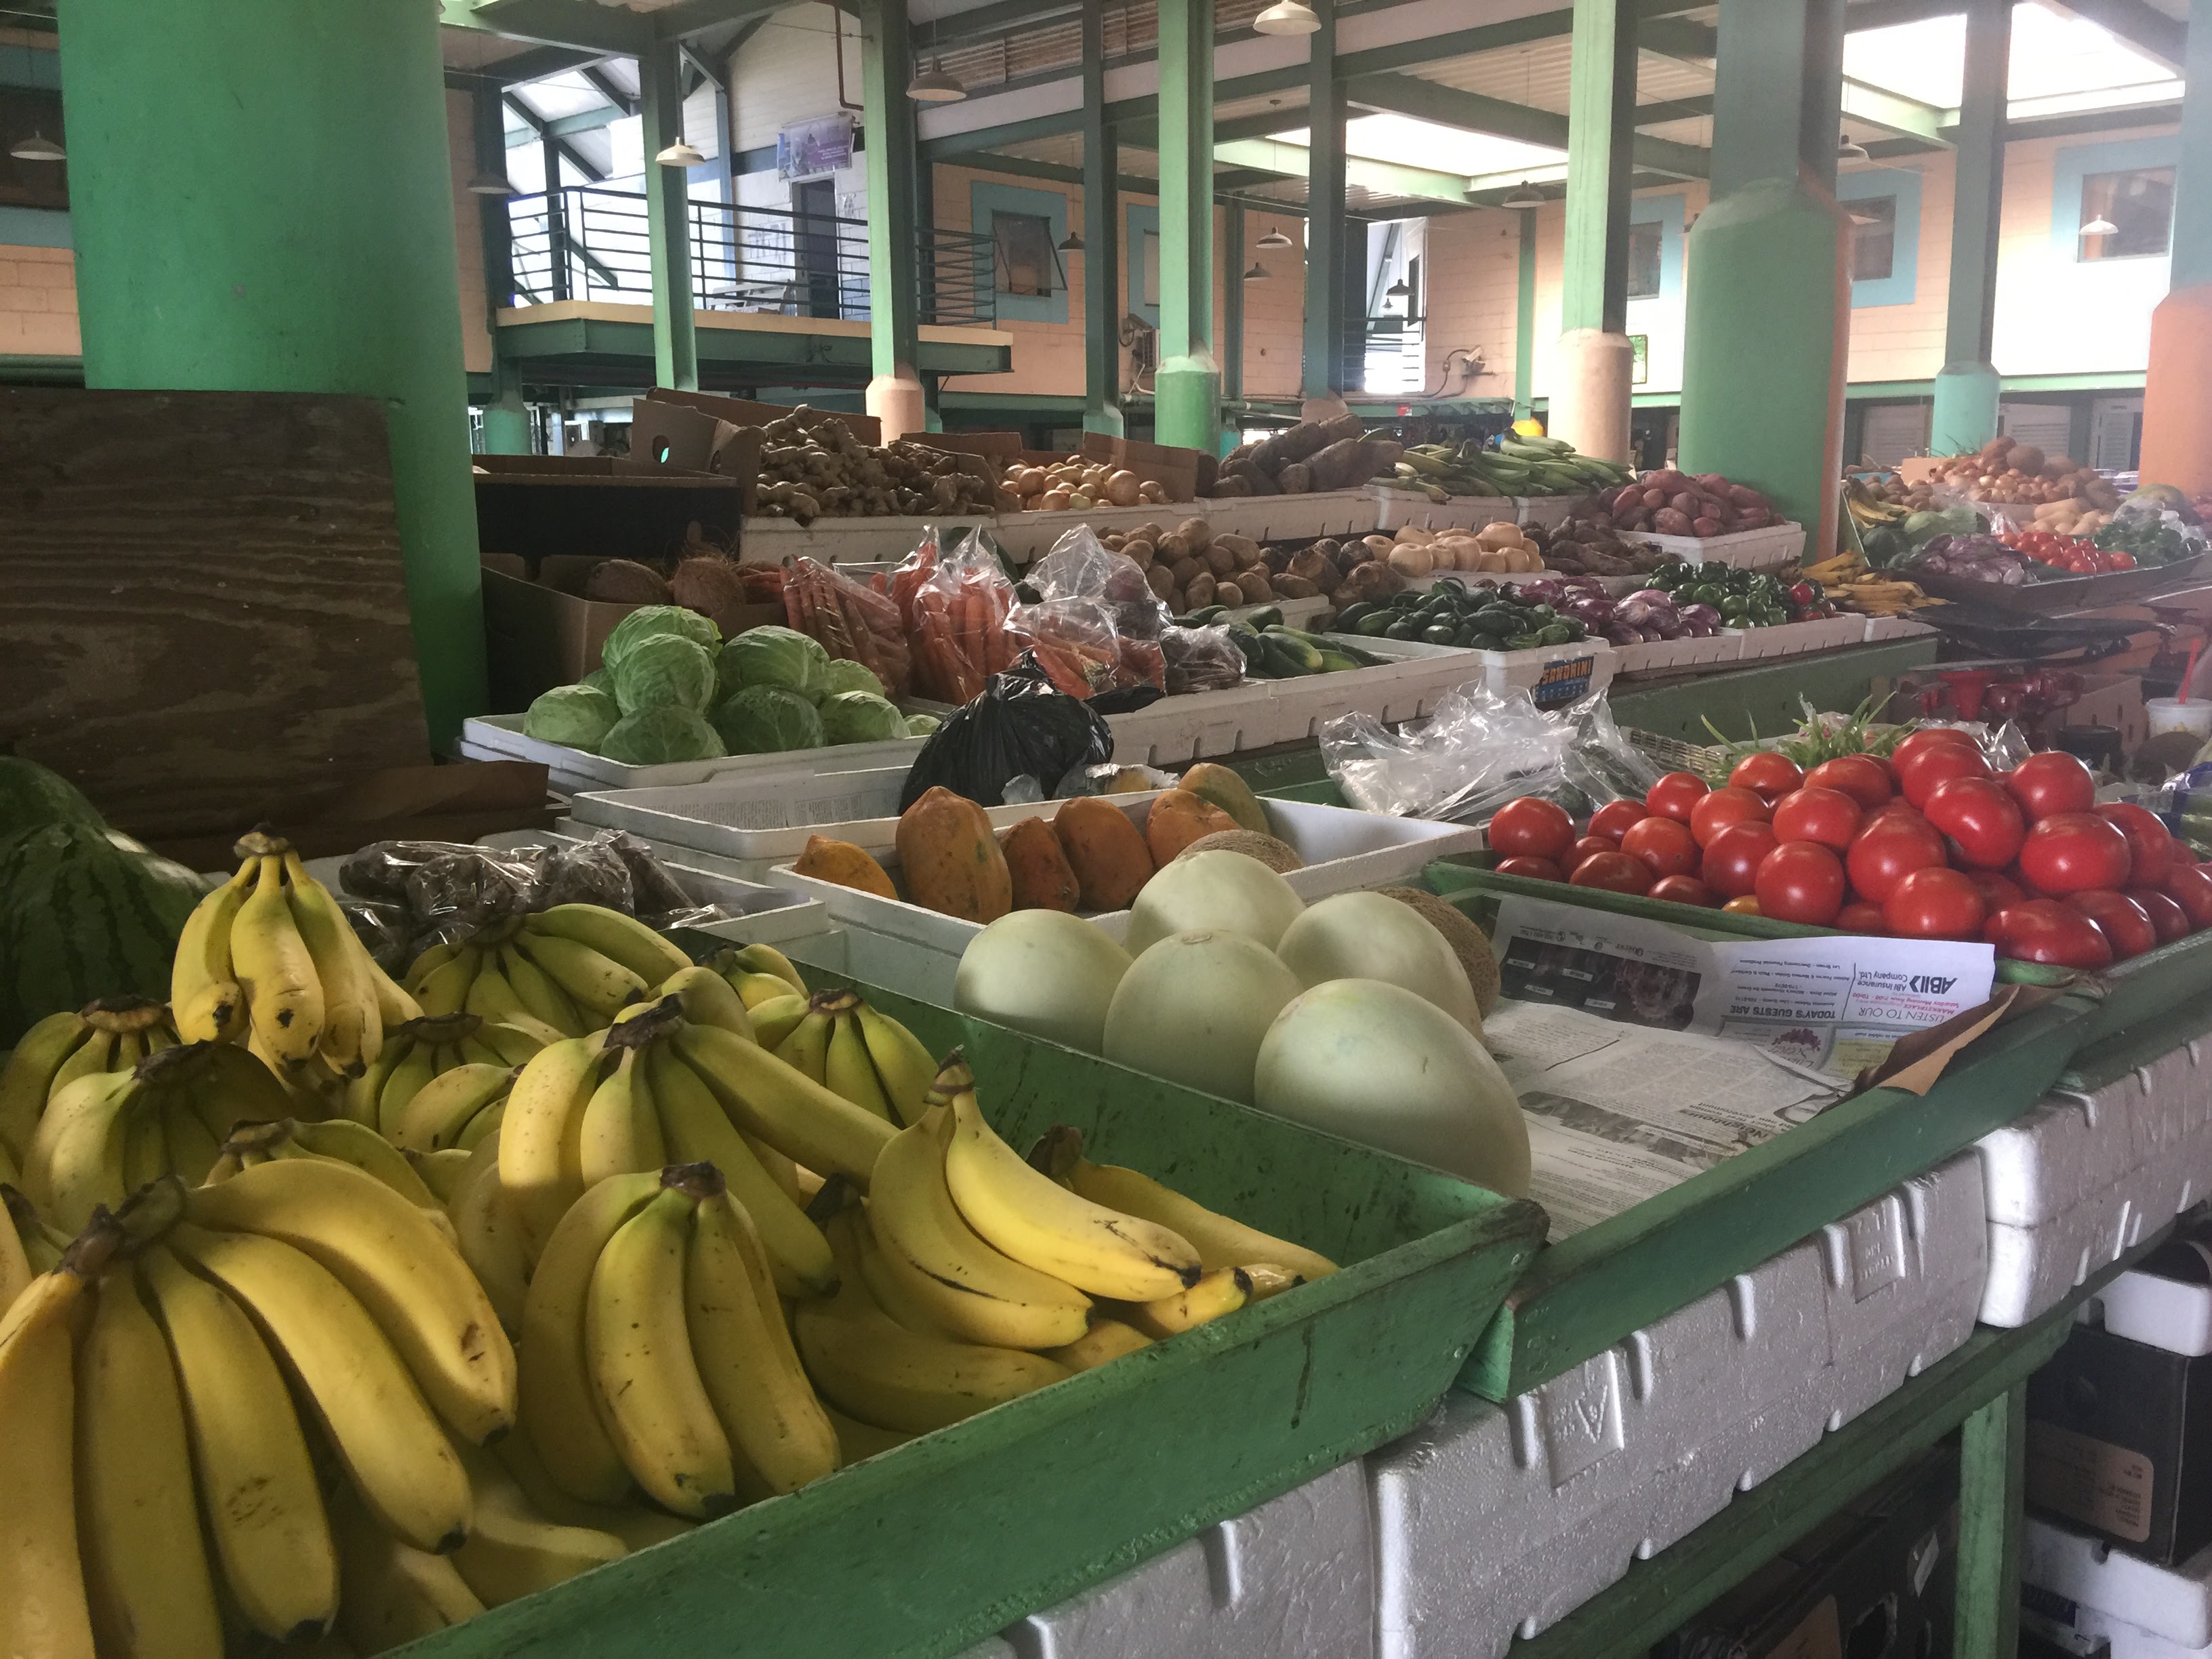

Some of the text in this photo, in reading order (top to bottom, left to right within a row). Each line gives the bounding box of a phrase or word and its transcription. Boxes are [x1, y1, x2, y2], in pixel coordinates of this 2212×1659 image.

[1873, 971, 1908, 983] Company
[1857, 981, 1892, 989] Insurance
[1729, 1005, 1836, 1019] TODAY'S GUESTS ARE
[1858, 1008, 1945, 1023] LISTEN TO OUR
[1903, 1004, 1954, 1015] MARKETPLACE
